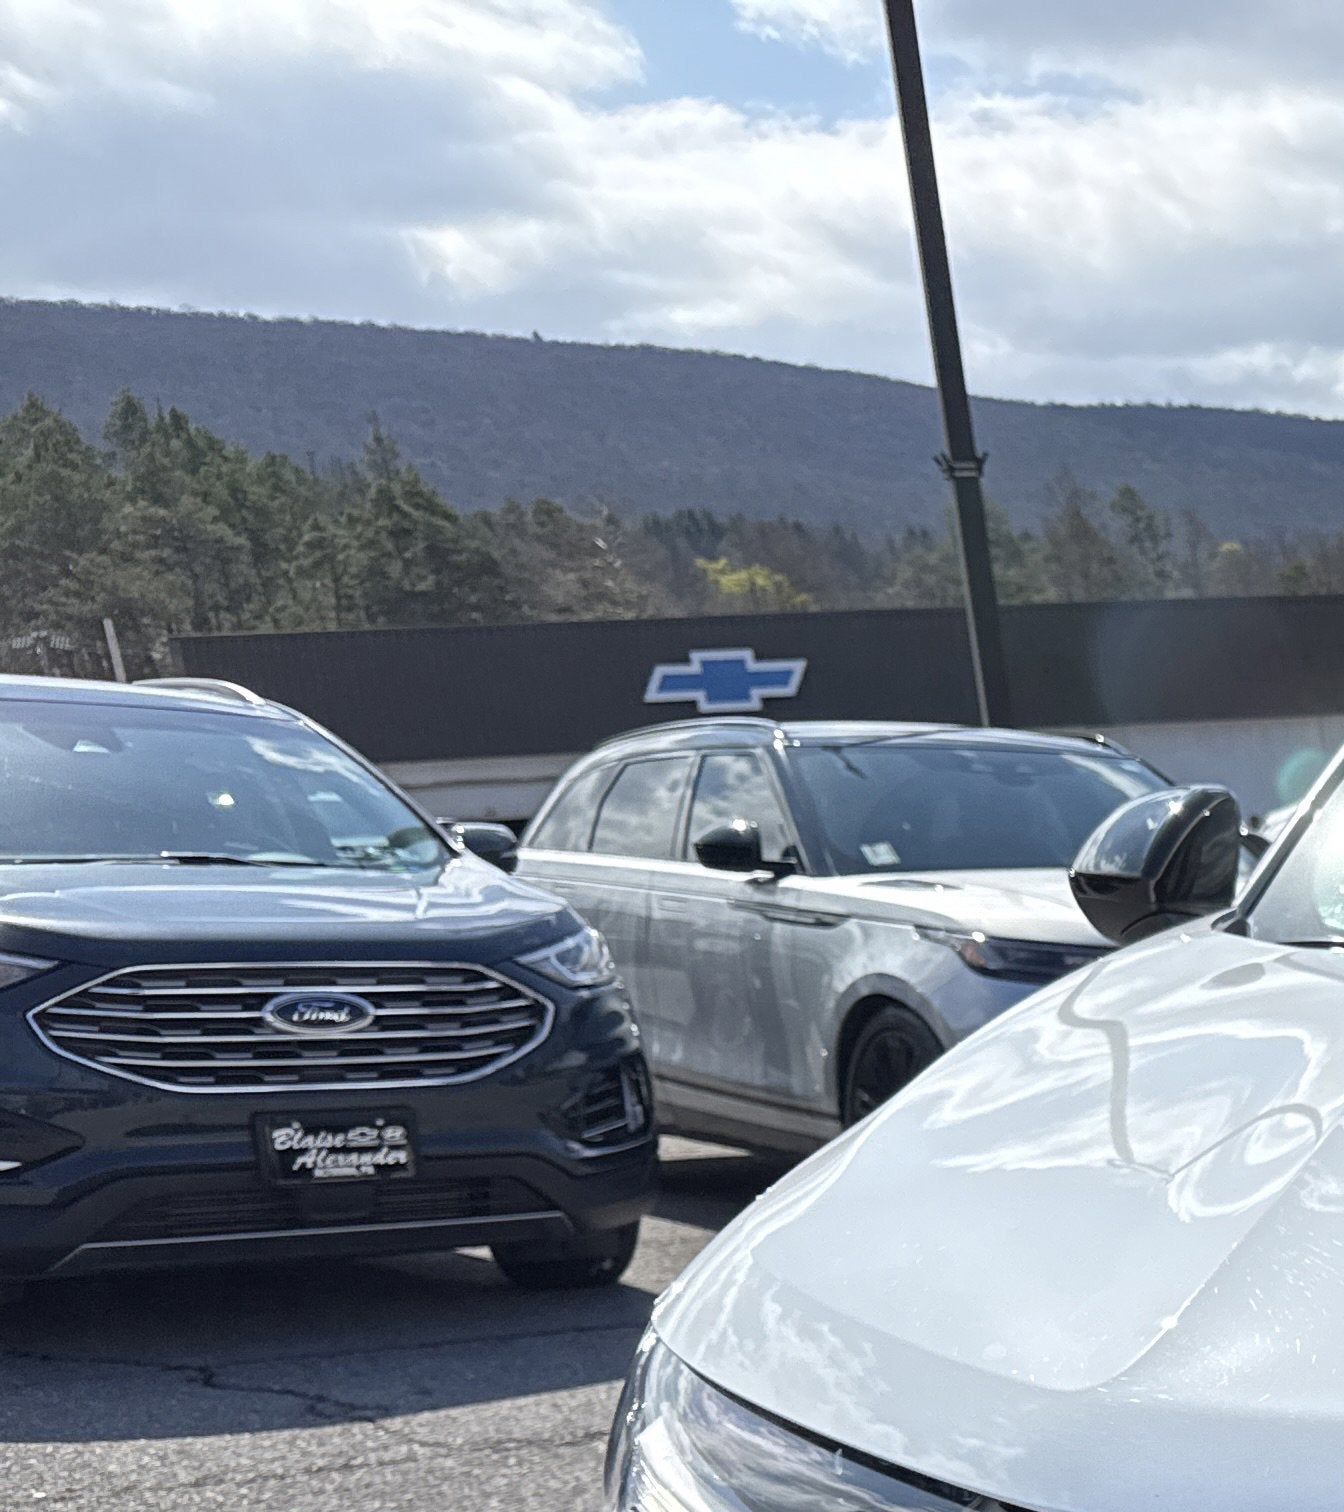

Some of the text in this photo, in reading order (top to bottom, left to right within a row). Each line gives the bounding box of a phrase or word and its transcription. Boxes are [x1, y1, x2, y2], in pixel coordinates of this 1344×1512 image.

[292, 1001, 351, 1022] Ford
[272, 1126, 345, 1151] Blaise
[292, 1146, 408, 1171] Alexander
